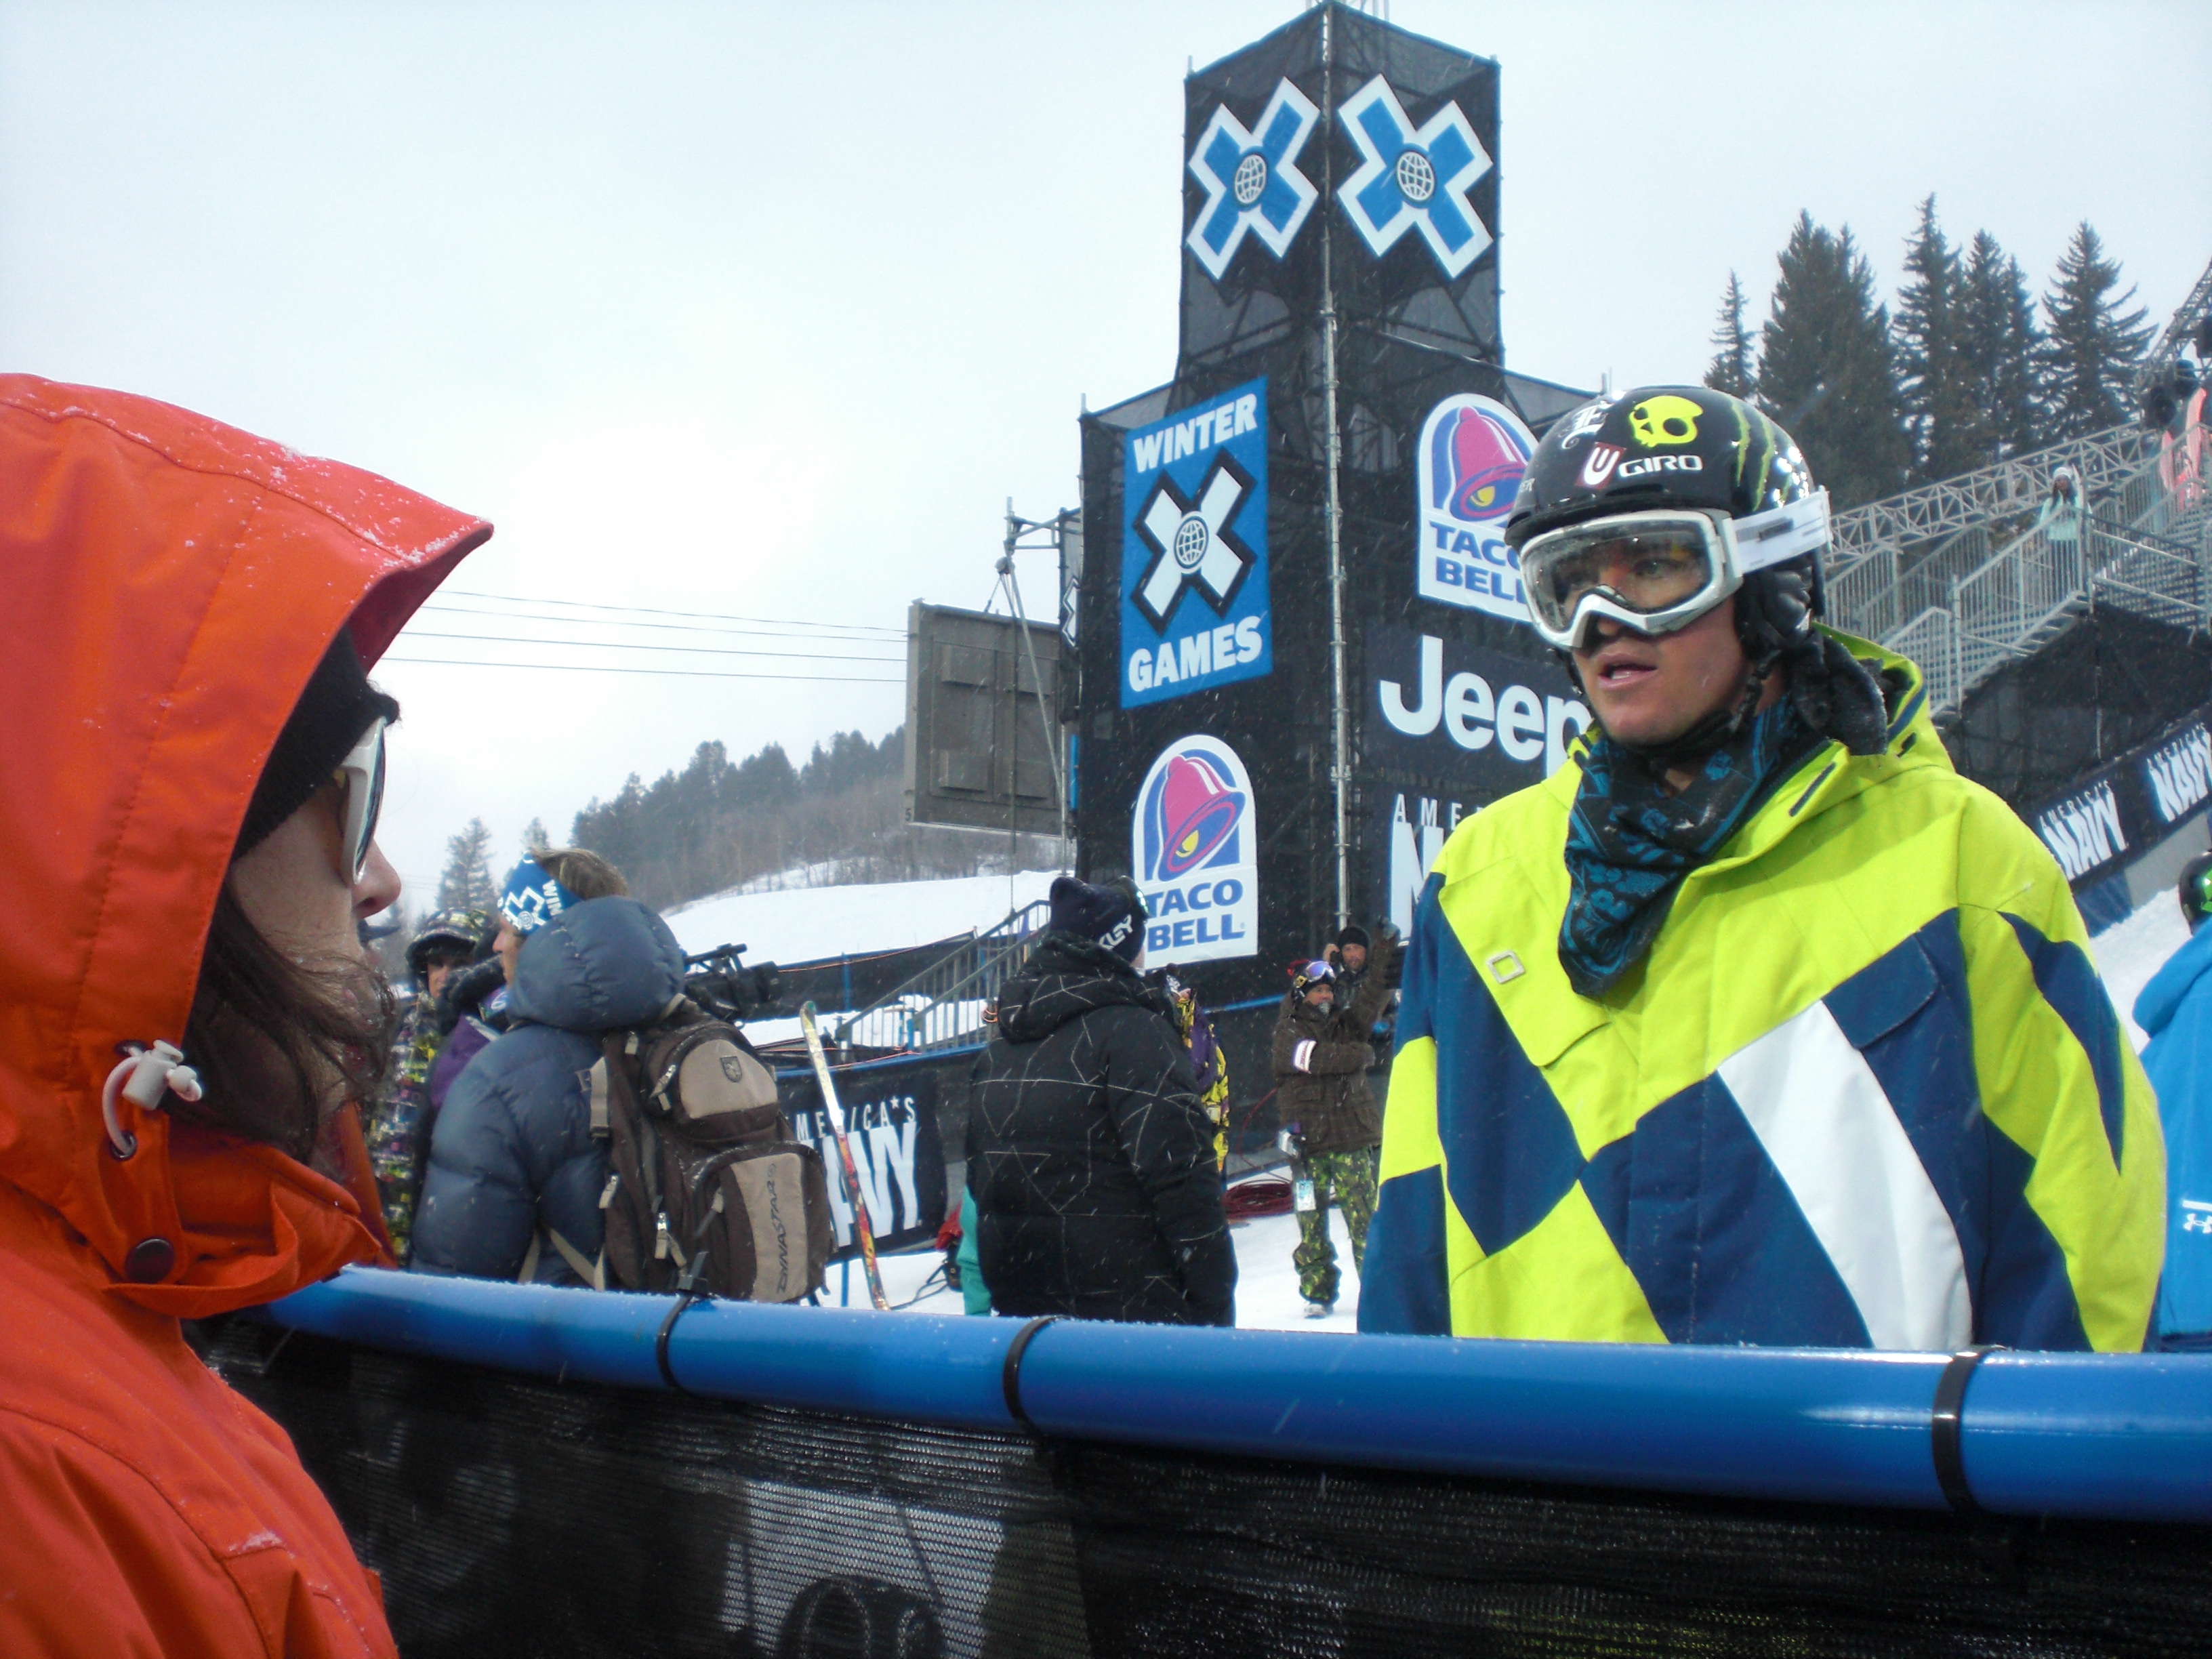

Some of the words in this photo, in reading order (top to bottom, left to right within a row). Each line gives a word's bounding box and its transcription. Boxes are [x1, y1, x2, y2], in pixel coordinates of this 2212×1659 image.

[1133, 393, 1258, 473] WINTER
[1618, 455, 1703, 477] GIRO
[1128, 615, 1263, 692] GAMES
[2043, 791, 2129, 881] NAVY
[1144, 878, 1243, 920] TACO
[1147, 914, 1246, 953] BELL
[766, 1180, 788, 1294] DYNASTAR
